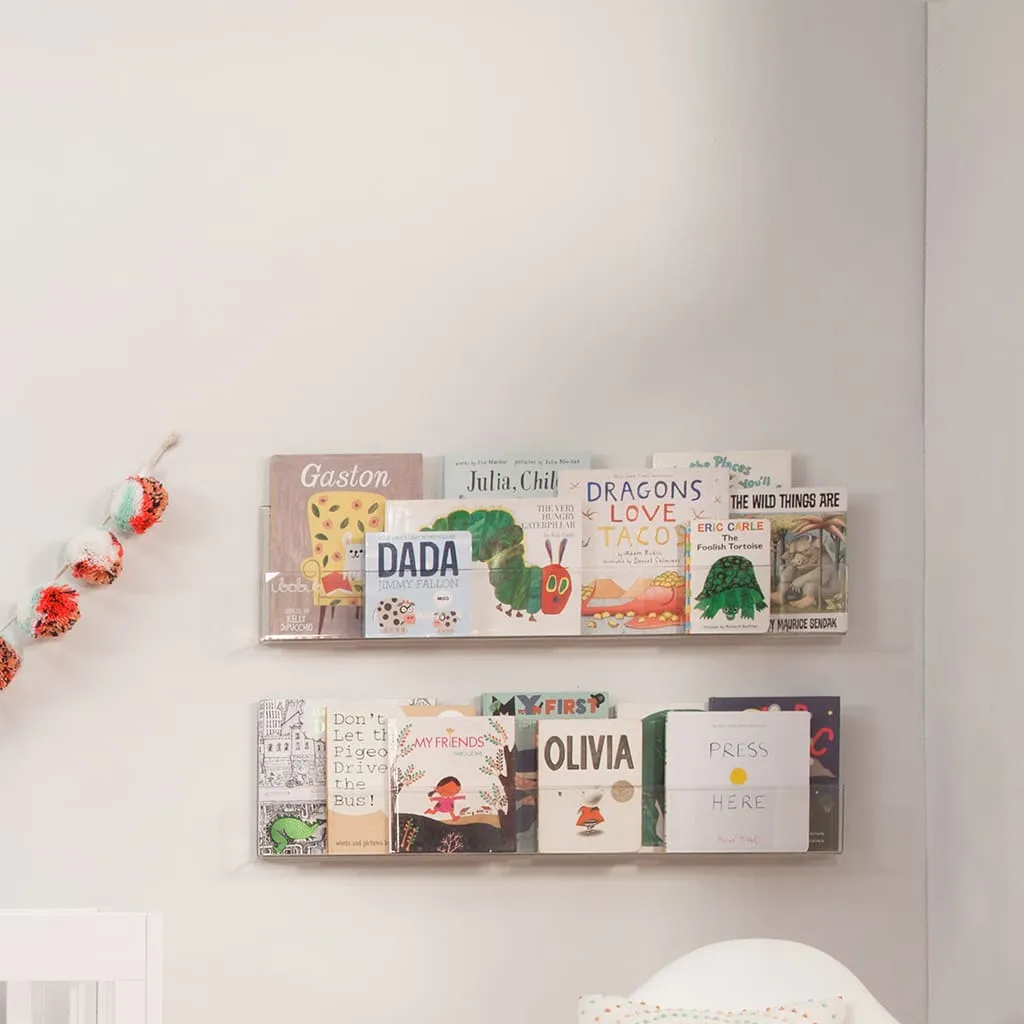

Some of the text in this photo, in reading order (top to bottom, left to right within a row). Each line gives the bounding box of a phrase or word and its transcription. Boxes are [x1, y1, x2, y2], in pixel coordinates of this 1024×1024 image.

[713, 455, 752, 475] Places
[300, 462, 391, 489] Gaston
[467, 470, 517, 493] Julia,
[587, 479, 703, 502] DRAGONS
[731, 492, 840, 510] THE WILD THINGS ARE
[537, 504, 576, 513] THE VERY
[610, 503, 676, 523] LOVE
[542, 513, 575, 521] HUNGRY
[522, 521, 576, 530] CATERPILLAR
[697, 521, 764, 533] ERIC CARLE
[598, 524, 687, 548] TACOS
[722, 534, 738, 542] The
[697, 542, 763, 551] Foolish Tortoise
[378, 540, 459, 578] DADA
[378, 579, 460, 592] JIMMY FALLON
[777, 618, 807, 631] MAURICE
[810, 617, 838, 630] SENDAK
[490, 695, 603, 715] MY FIRST
[333, 713, 386, 725] Don't
[333, 729, 388, 742] Let th
[414, 737, 485, 748] MY FRIENDS
[333, 745, 388, 760] Pigeo
[544, 734, 634, 771] OLIVIA
[709, 742, 769, 758] PRESS
[333, 761, 388, 774] Drive
[335, 778, 366, 790] the
[333, 794, 375, 807] Bus!
[712, 794, 766, 811] HERE
